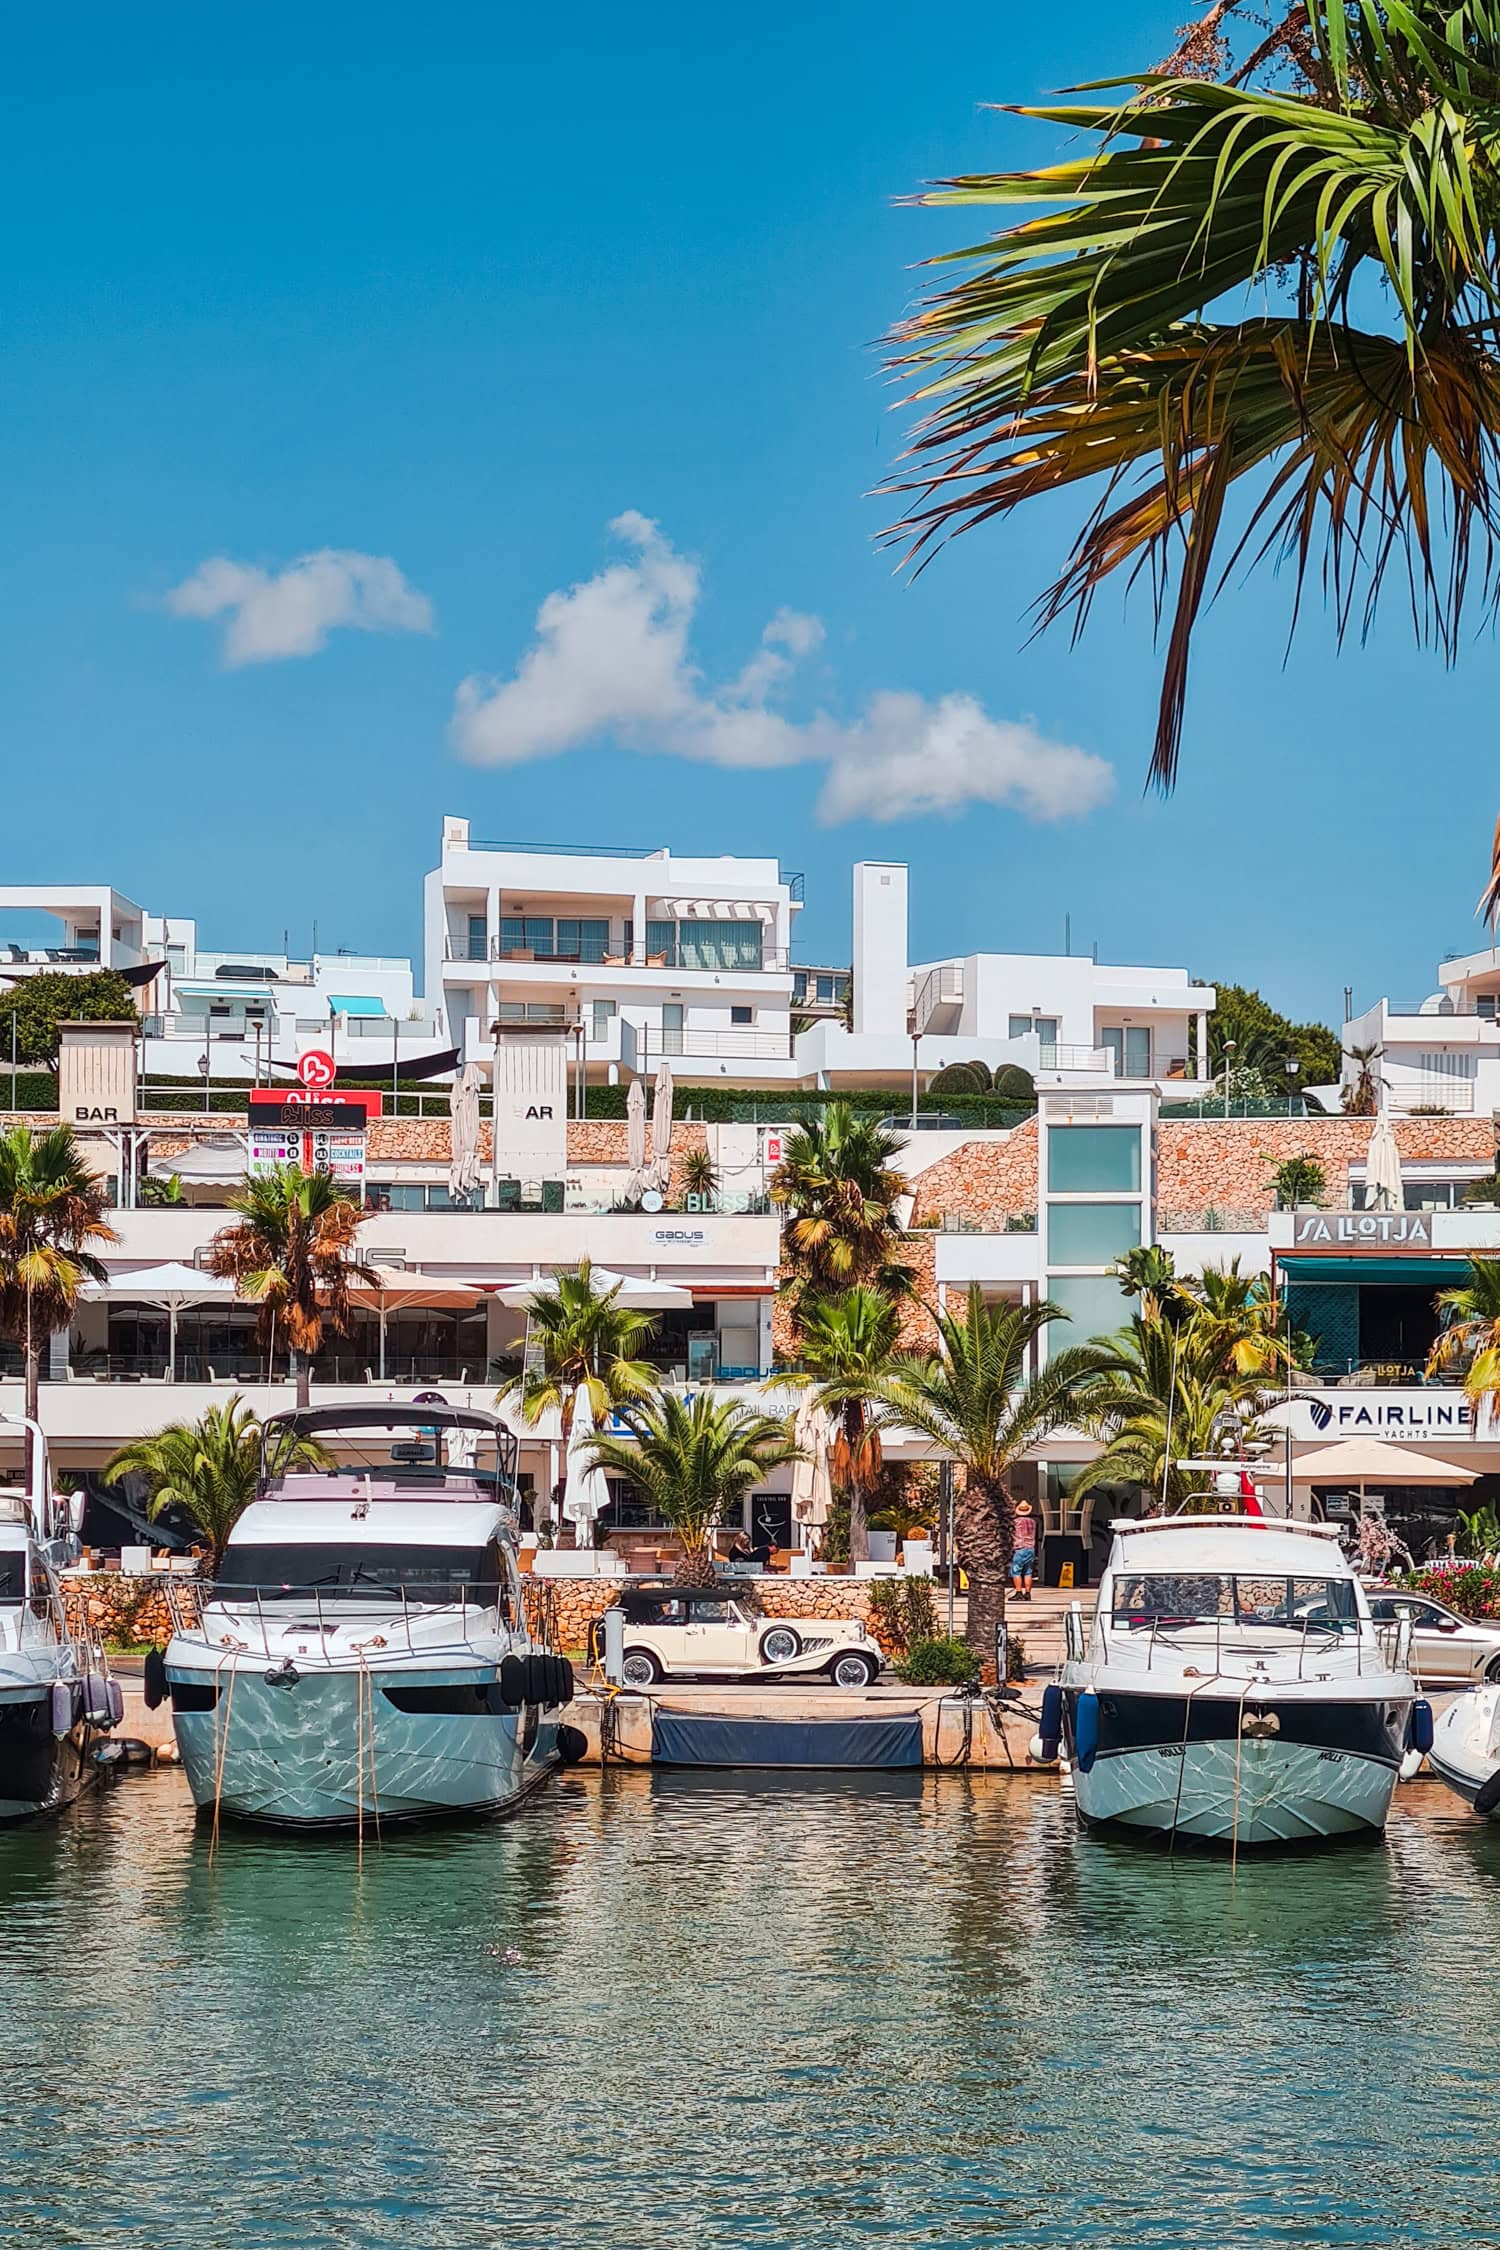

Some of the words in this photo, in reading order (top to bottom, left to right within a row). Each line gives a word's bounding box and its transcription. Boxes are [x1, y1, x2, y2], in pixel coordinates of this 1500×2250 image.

[76, 1106, 118, 1121] BAR
[1296, 1217, 1332, 1241] SA
[1338, 1216, 1429, 1241] LLOTJA
[1339, 1406, 1471, 1425] FAIRLINE
[1384, 1430, 1428, 1438] YACHTS
